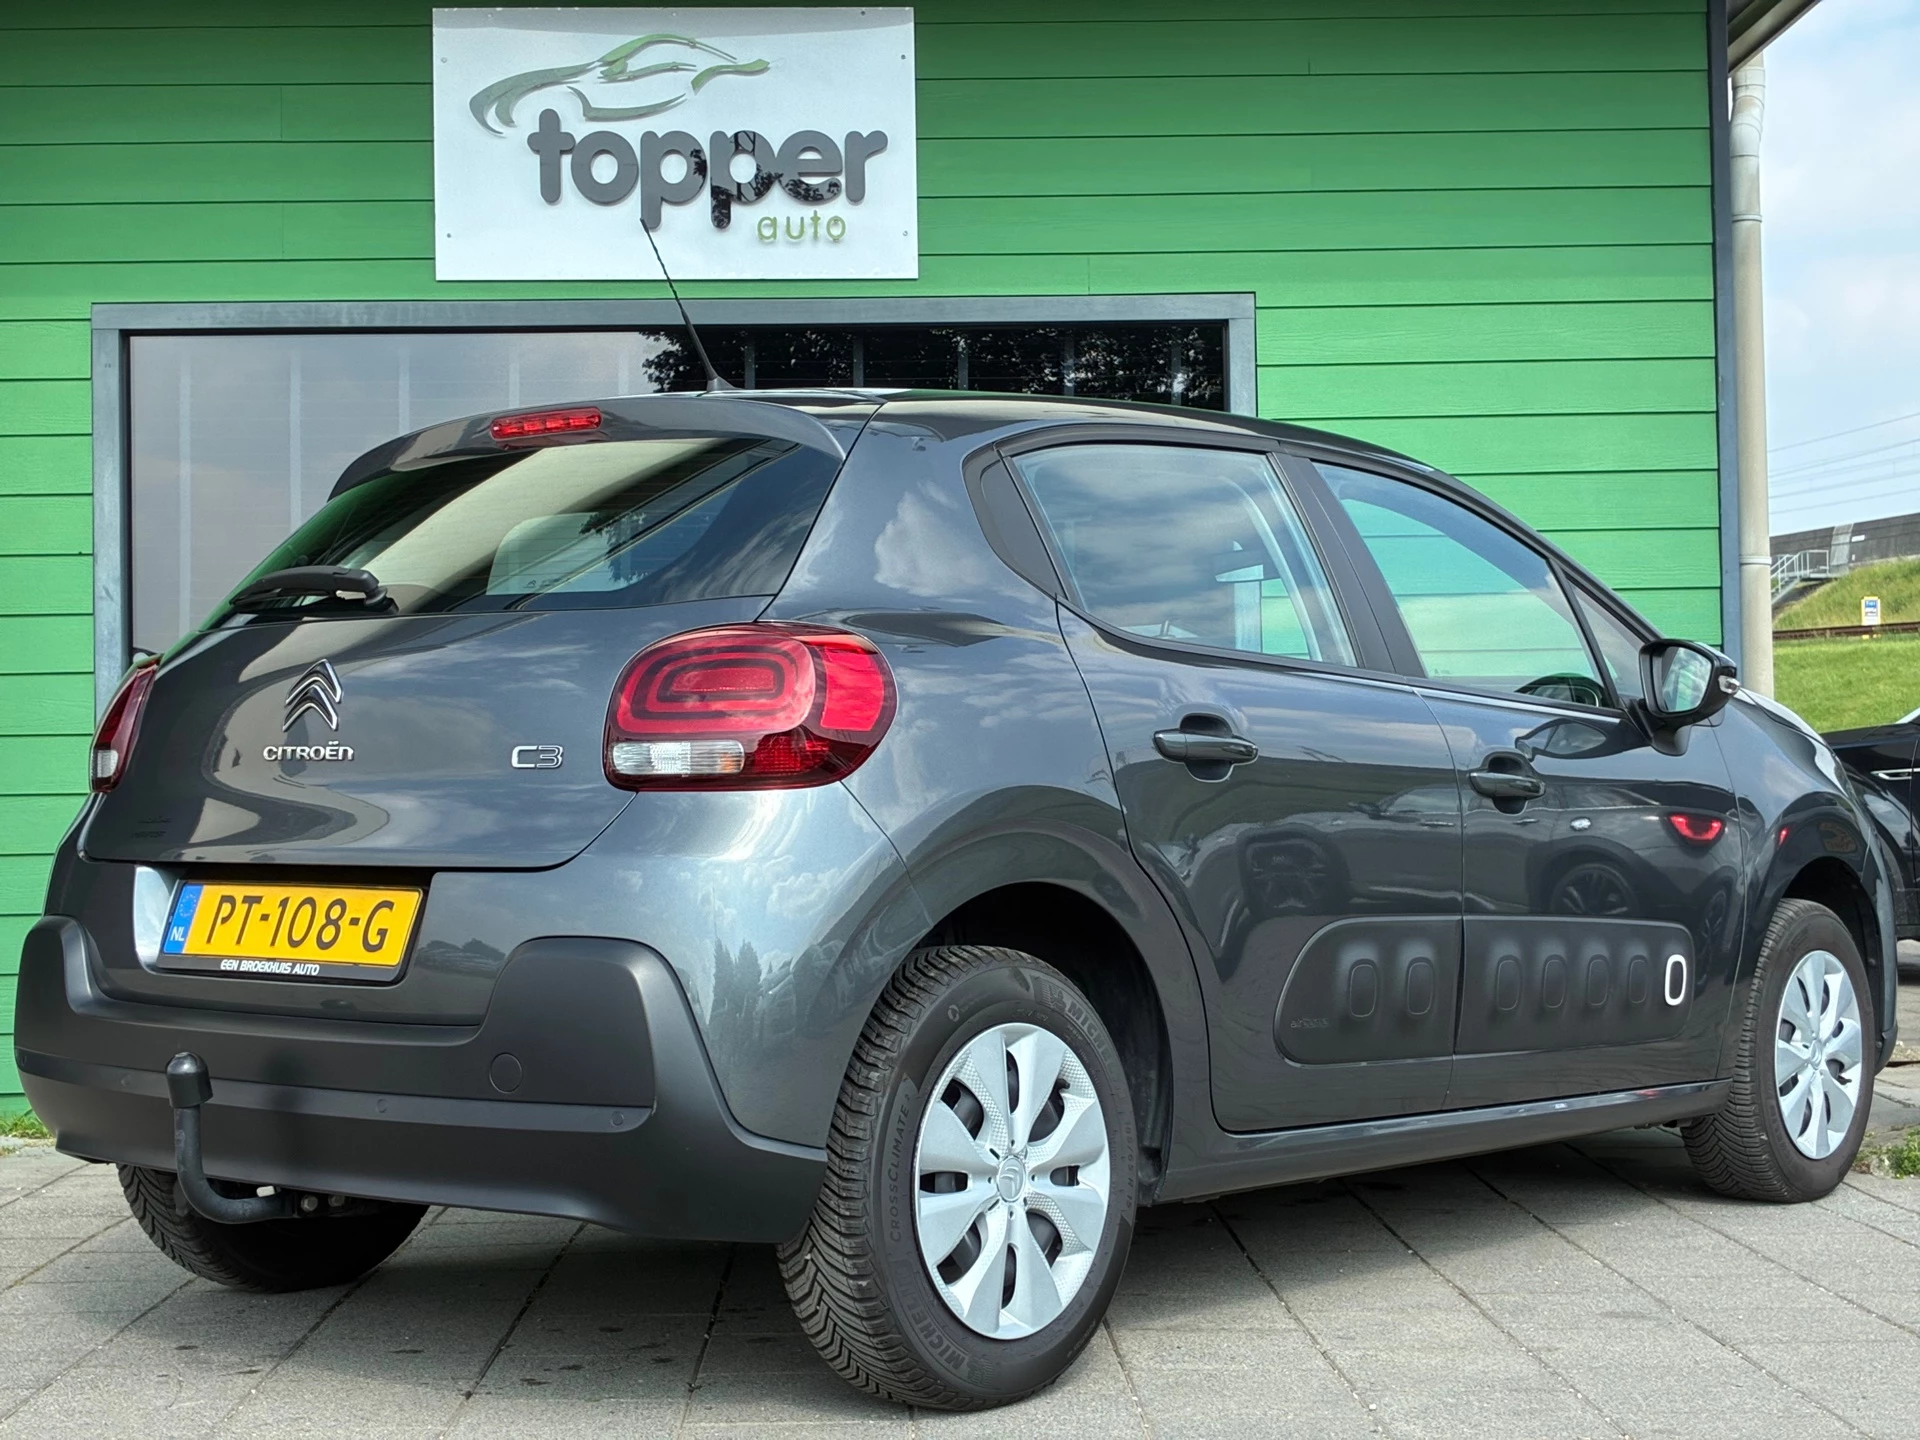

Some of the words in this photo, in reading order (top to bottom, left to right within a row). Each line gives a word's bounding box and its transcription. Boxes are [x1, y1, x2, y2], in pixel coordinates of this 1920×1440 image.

[527, 108, 888, 229] topper
[757, 210, 847, 243] auto
[511, 745, 564, 769] C3
[170, 926, 185, 942] NL
[206, 894, 395, 953] PT-108-G
[220, 959, 239, 970] EEN
[240, 960, 293, 974] BROEKHUIS
[292, 963, 320, 975] AUTO
[888, 1104, 910, 1243] CROSSCLIMATE
